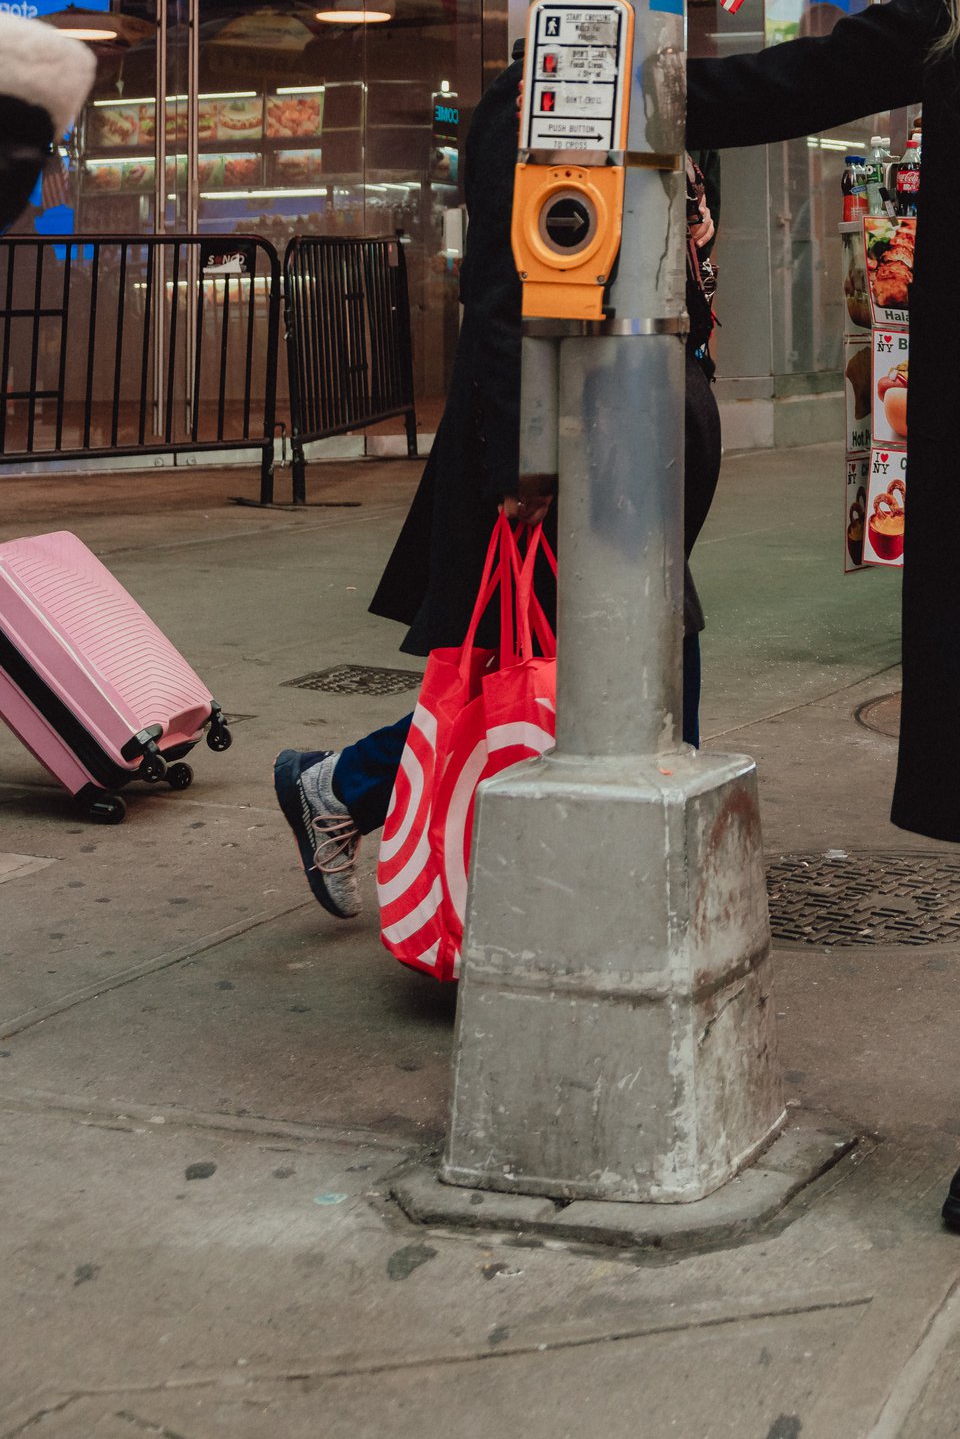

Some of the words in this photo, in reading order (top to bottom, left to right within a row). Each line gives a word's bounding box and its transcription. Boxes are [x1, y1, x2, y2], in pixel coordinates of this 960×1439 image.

[548, 124, 568, 133] PUSH
[569, 124, 596, 133] BUTTON
[553, 140, 565, 149] TO
[565, 141, 588, 150] CROSS
[878, 334, 883, 344] I
[876, 343, 894, 353] NY
[875, 452, 881, 463] I
[872, 463, 890, 475] NY
